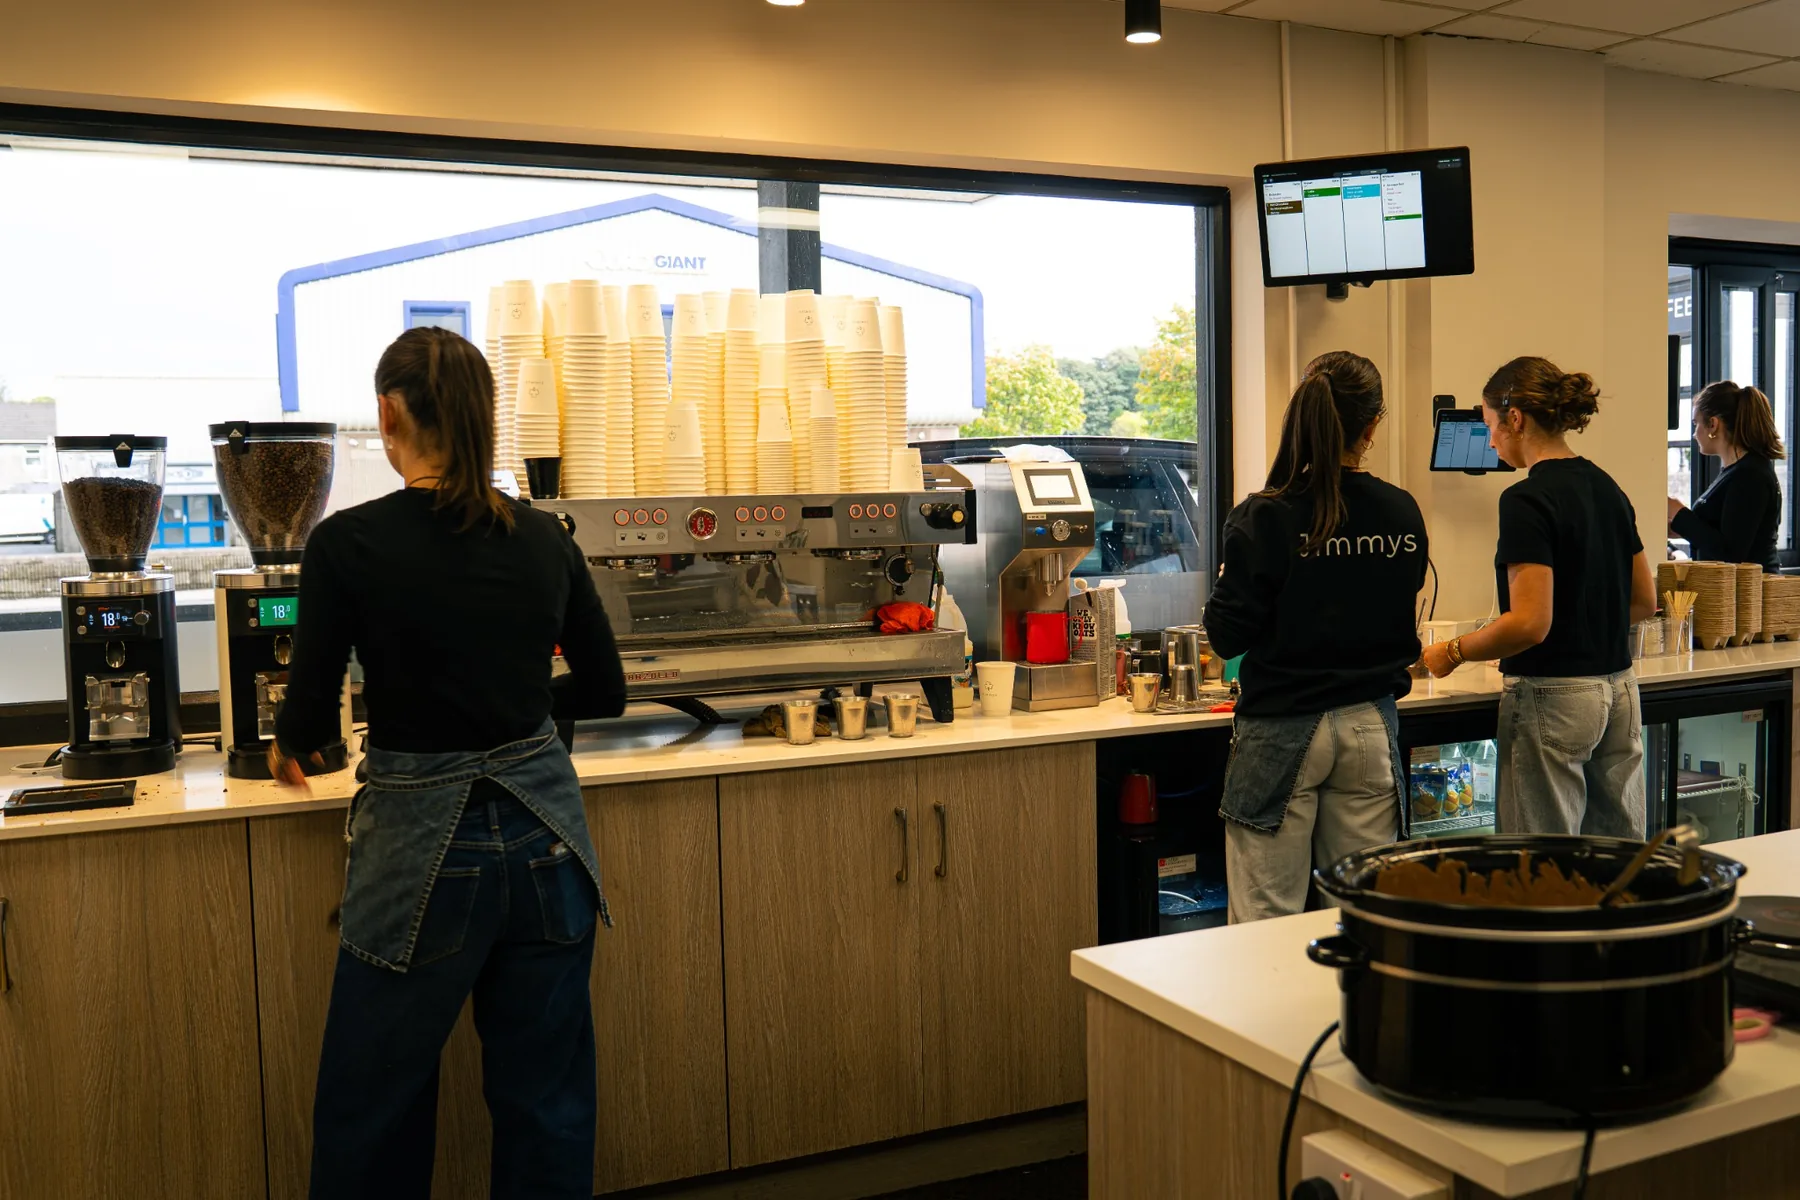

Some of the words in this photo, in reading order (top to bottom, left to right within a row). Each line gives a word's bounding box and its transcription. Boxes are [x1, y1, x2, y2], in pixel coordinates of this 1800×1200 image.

[655, 255, 706, 269] GIANT
[1300, 533, 1417, 558] Jmmys
[1076, 609, 1089, 617] WE
